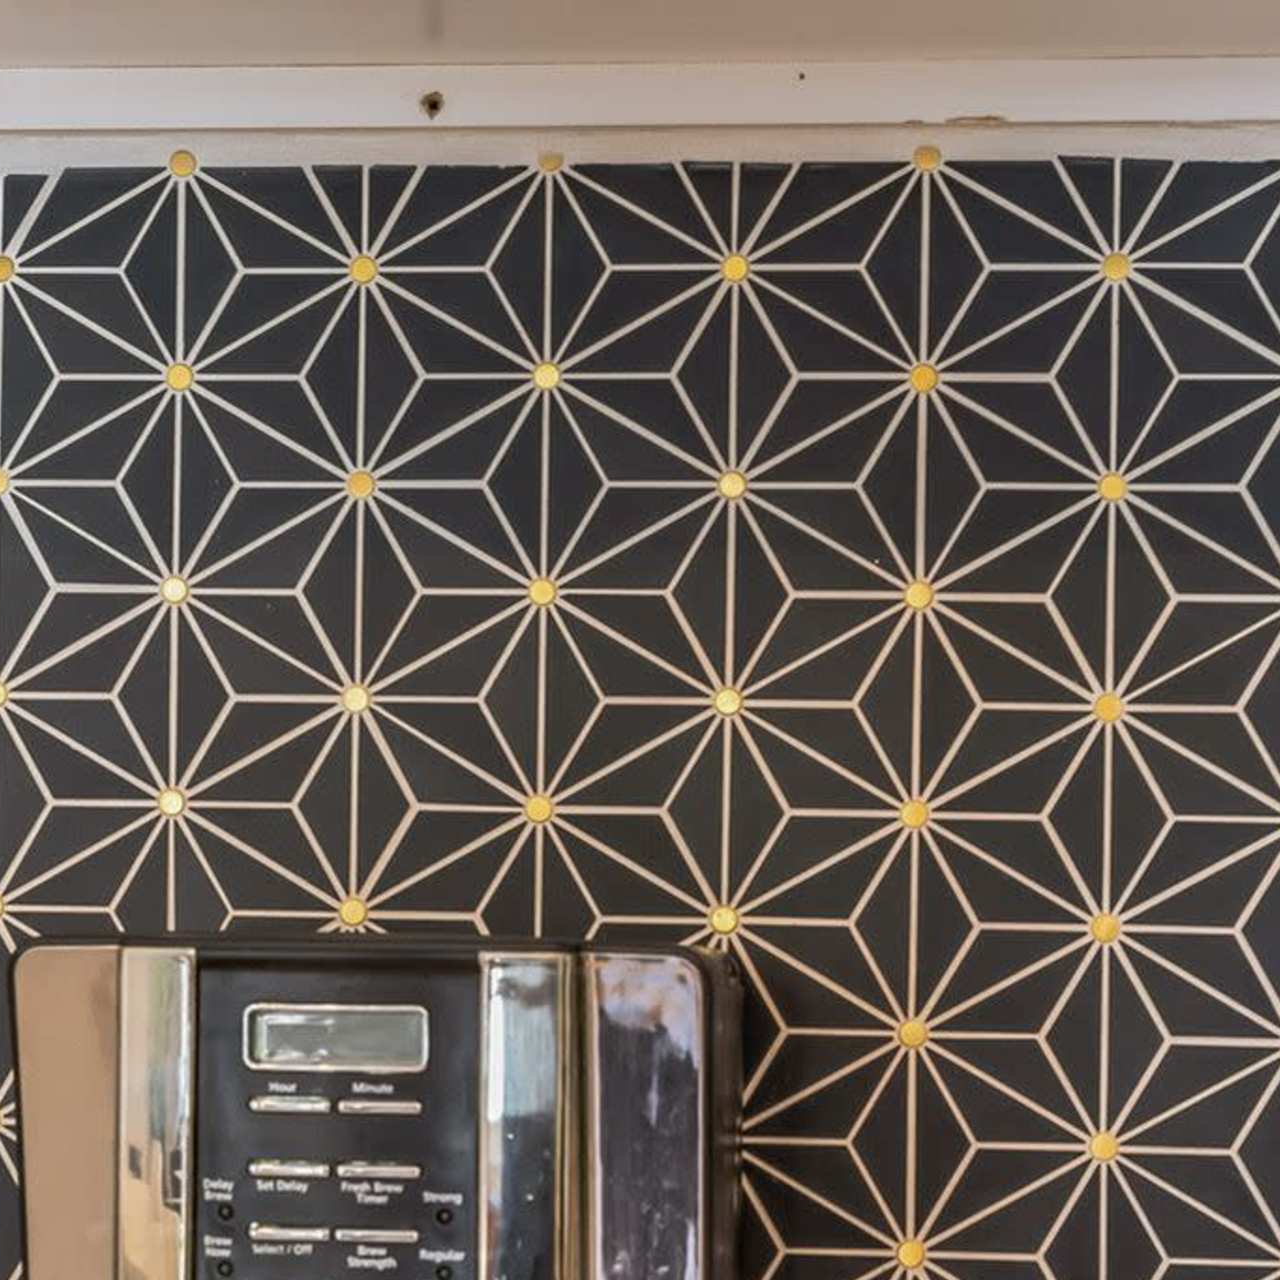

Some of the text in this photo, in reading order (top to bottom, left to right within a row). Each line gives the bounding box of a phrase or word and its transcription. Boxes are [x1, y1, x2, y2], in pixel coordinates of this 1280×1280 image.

[268, 1081, 297, 1093] Hour
[352, 1081, 394, 1094] Minute
[203, 1178, 234, 1192] Delay
[256, 1179, 308, 1194] Set Delay
[341, 1181, 403, 1193] Fresh Brew
[204, 1190, 232, 1200] Brew
[422, 1190, 463, 1205] Strong
[204, 1235, 232, 1246] Brew
[252, 1243, 284, 1254] Select
[293, 1243, 313, 1255] Off
[357, 1245, 387, 1256] Brew
[419, 1248, 465, 1263] Regular
[347, 1256, 397, 1270] Strength
